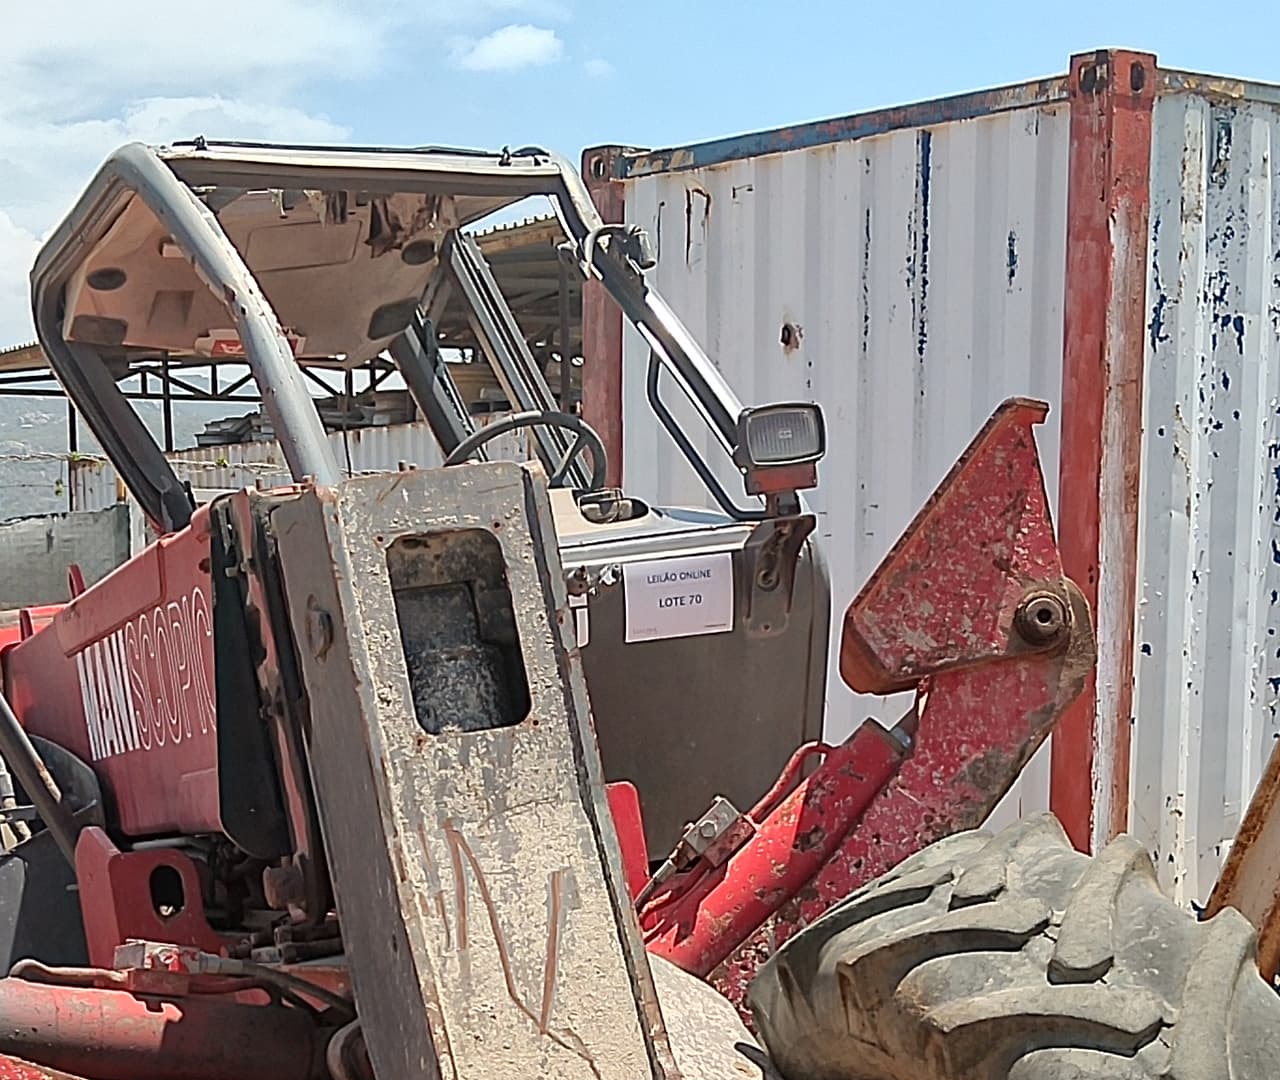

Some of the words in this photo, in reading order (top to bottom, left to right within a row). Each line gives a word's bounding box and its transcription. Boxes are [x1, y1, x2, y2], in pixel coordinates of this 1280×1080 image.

[647, 572, 677, 584] LEILÃO
[679, 569, 711, 580] ONLINE
[659, 596, 686, 608] LOTE
[689, 594, 702, 605] 70
